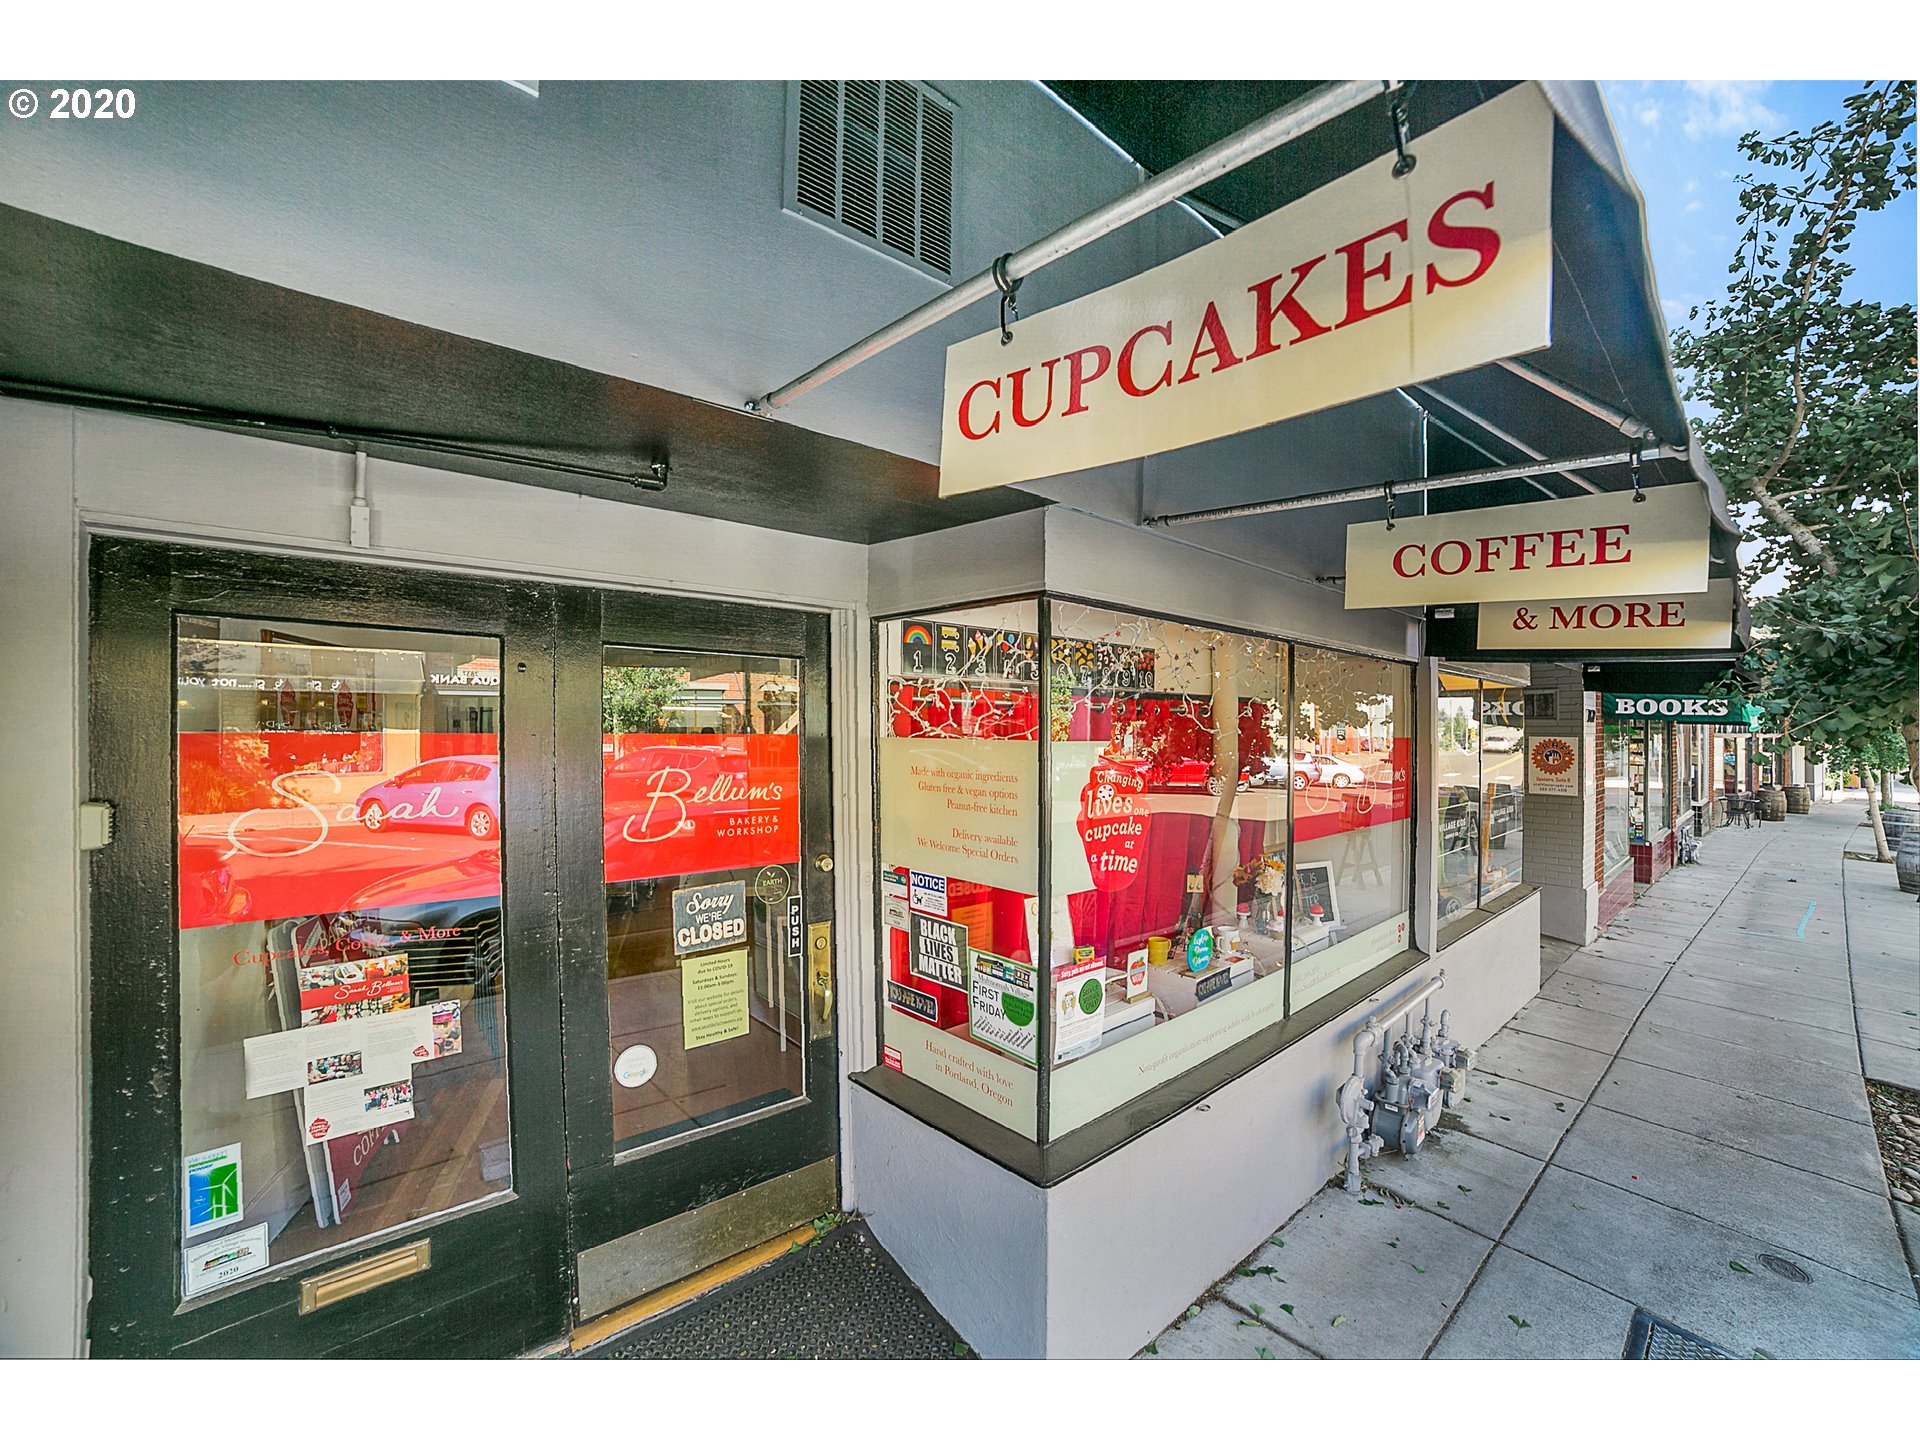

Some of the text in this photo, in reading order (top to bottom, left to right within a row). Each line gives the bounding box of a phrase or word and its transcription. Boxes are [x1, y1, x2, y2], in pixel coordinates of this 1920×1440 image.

[958, 180, 1502, 441] CUPCAKES
[1392, 524, 1632, 578] COFFEE
[1512, 601, 1685, 630] & MORE
[913, 650, 923, 673] 1
[945, 652, 956, 675] 2
[1615, 698, 1729, 717] BOOKS
[910, 765, 1018, 783] Made with organic ingredients
[1096, 769, 1144, 792] Changing
[918, 780, 1018, 801] Gluten free & vegan options
[219, 770, 459, 861] Sarah
[622, 765, 783, 843] Bellum's
[947, 798, 1018, 816] Peanut-free kitchen
[1087, 789, 1150, 818] lives one
[716, 825, 779, 837] WORKSHOP
[729, 815, 778, 825] BAKERY &
[1085, 816, 1142, 842] cupcake
[917, 836, 1019, 863] We Welcome Special Orders
[952, 827, 1018, 847] Delivery available
[1124, 840, 1135, 849] at
[1090, 849, 1138, 873] a time
[763, 877, 783, 887] EARTH
[911, 873, 945, 891] NOTICE
[686, 892, 735, 915] Sorry
[695, 911, 723, 924] WE'RE
[791, 905, 800, 948] PUSH
[677, 917, 745, 948] CLOSED
[920, 918, 957, 946] BLACK
[232, 943, 329, 967] Cupcakes,
[335, 933, 396, 951] Coffee,
[400, 929, 413, 943] &
[417, 925, 461, 941] More
[924, 938, 954, 963] LIVES
[919, 953, 962, 985] MATTER
[972, 980, 1000, 1002] FIRST
[972, 995, 1007, 1020] FRIDAY
[925, 1040, 1014, 1089] Hand crafted with love
[935, 1060, 1013, 1107] in Portland, Oregon
[218, 1265, 239, 1279] 2020
